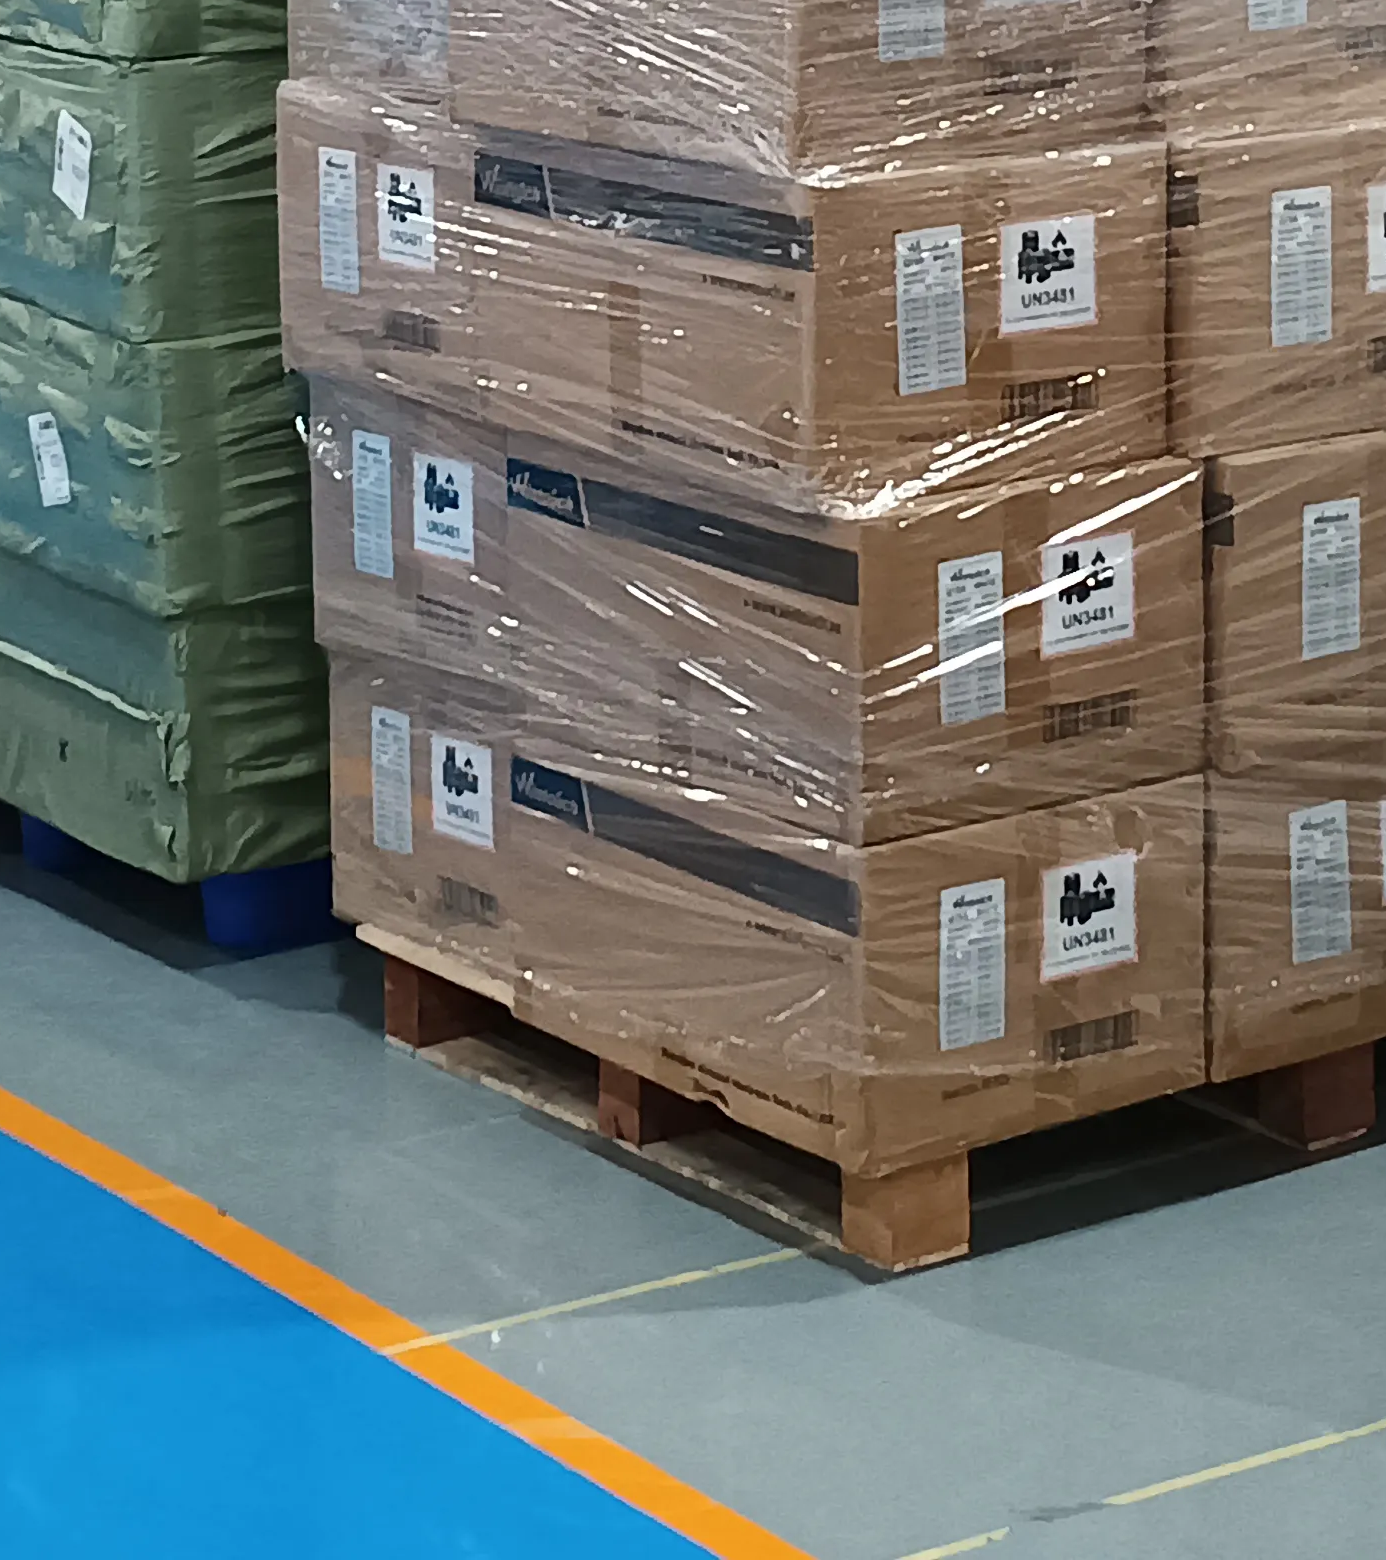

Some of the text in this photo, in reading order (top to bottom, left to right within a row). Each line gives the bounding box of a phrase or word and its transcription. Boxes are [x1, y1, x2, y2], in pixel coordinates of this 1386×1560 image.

[1021, 287, 1075, 309] UN3481
[1061, 606, 1114, 629] UN3481
[1062, 927, 1115, 951] UN3481
